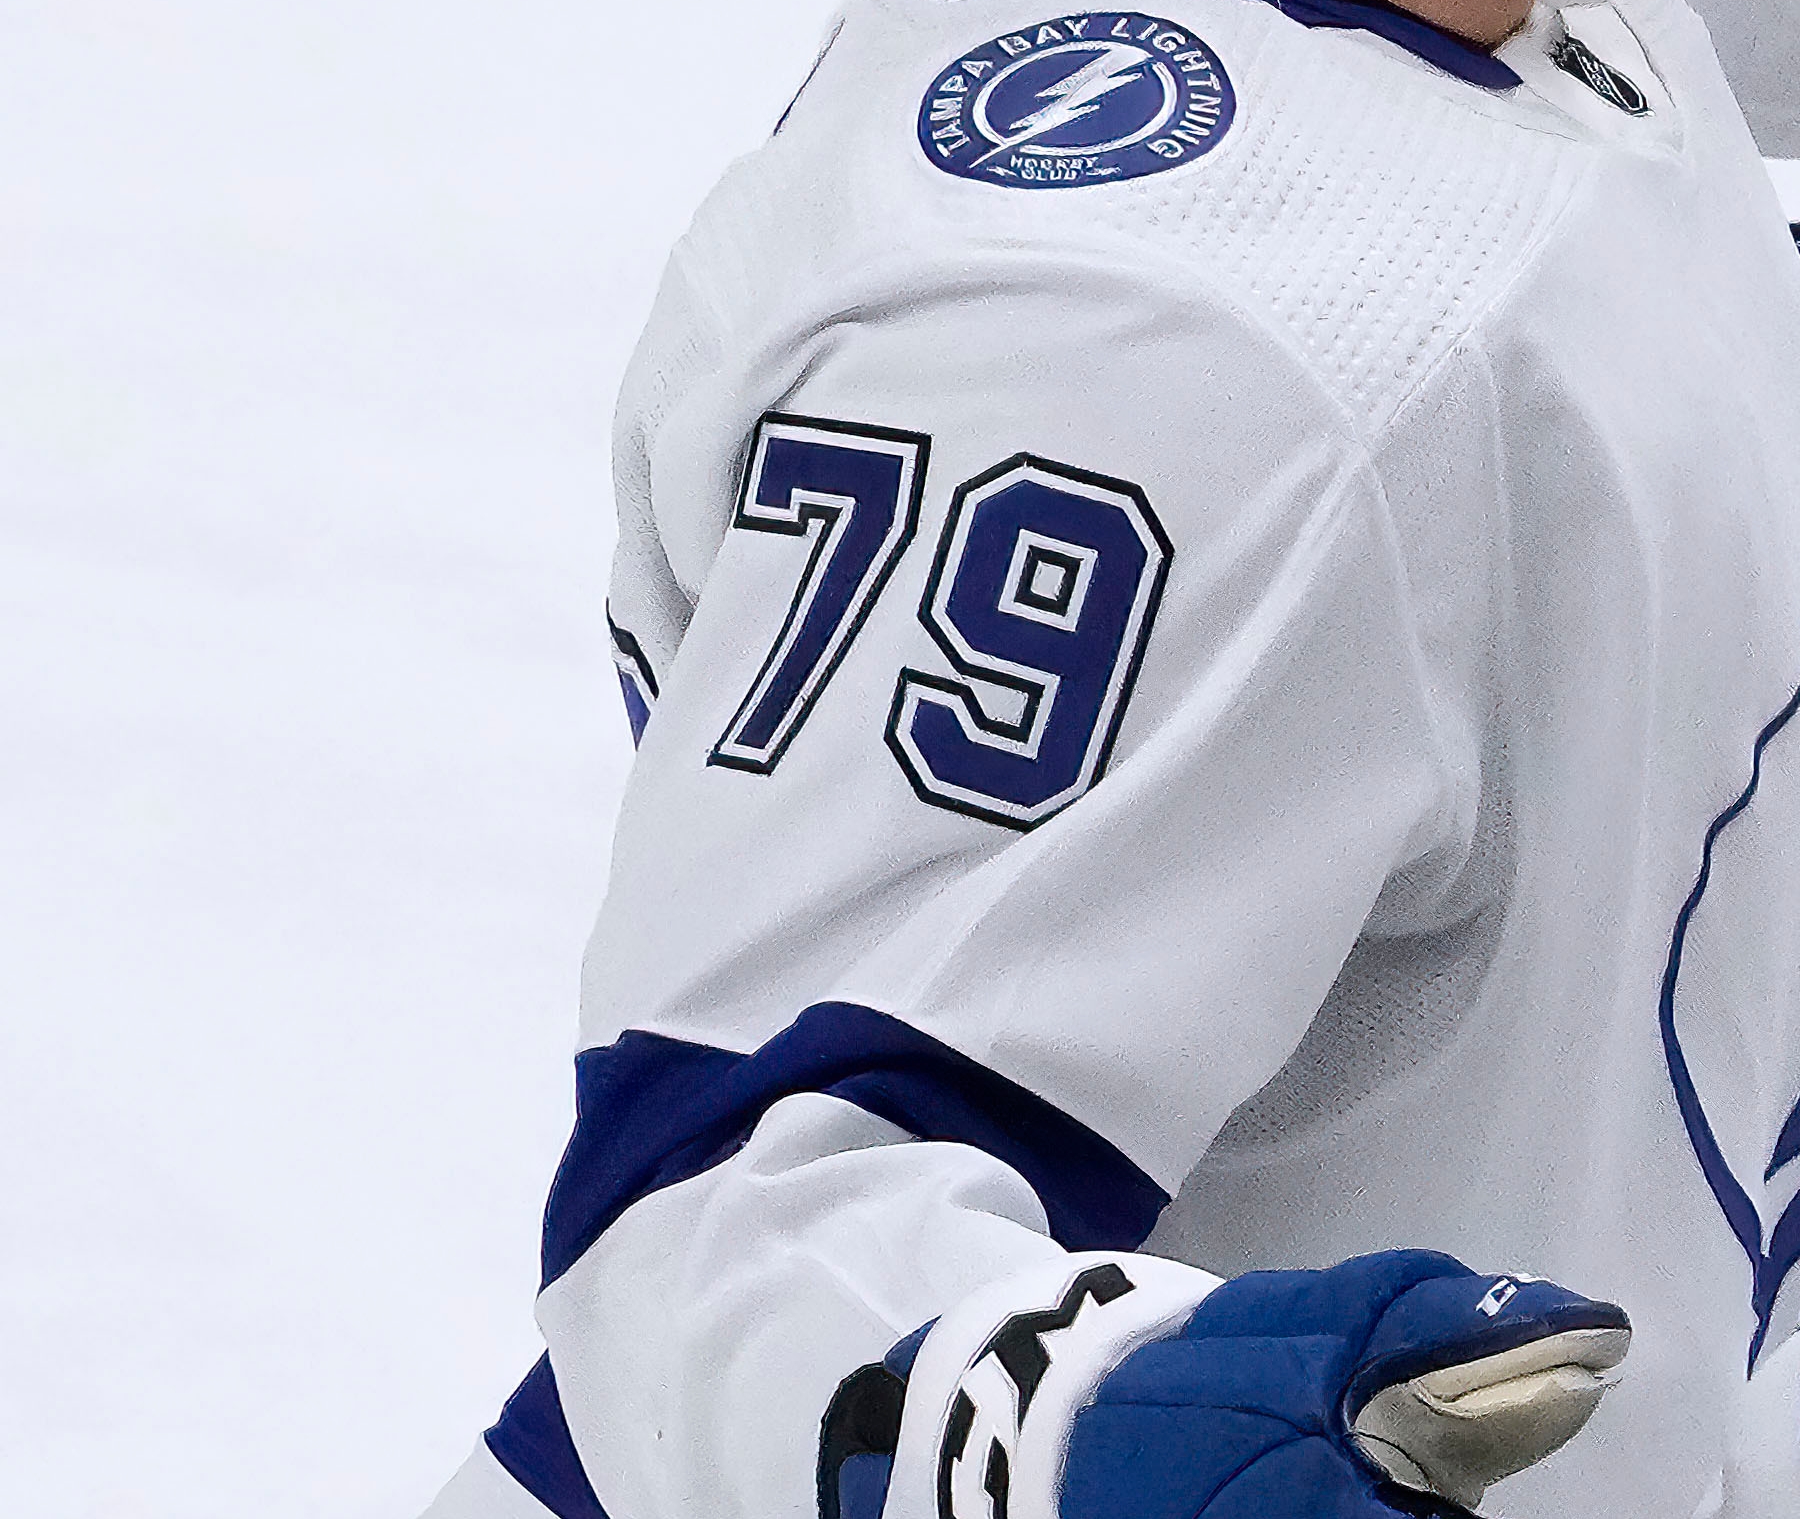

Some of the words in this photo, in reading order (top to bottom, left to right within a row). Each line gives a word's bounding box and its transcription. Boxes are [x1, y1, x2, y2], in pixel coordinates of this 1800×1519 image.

[929, 58, 994, 159] TAMPA
[997, 18, 1089, 57] BAY
[1110, 17, 1222, 160] LIGHTNING
[705, 409, 1175, 834] 79
